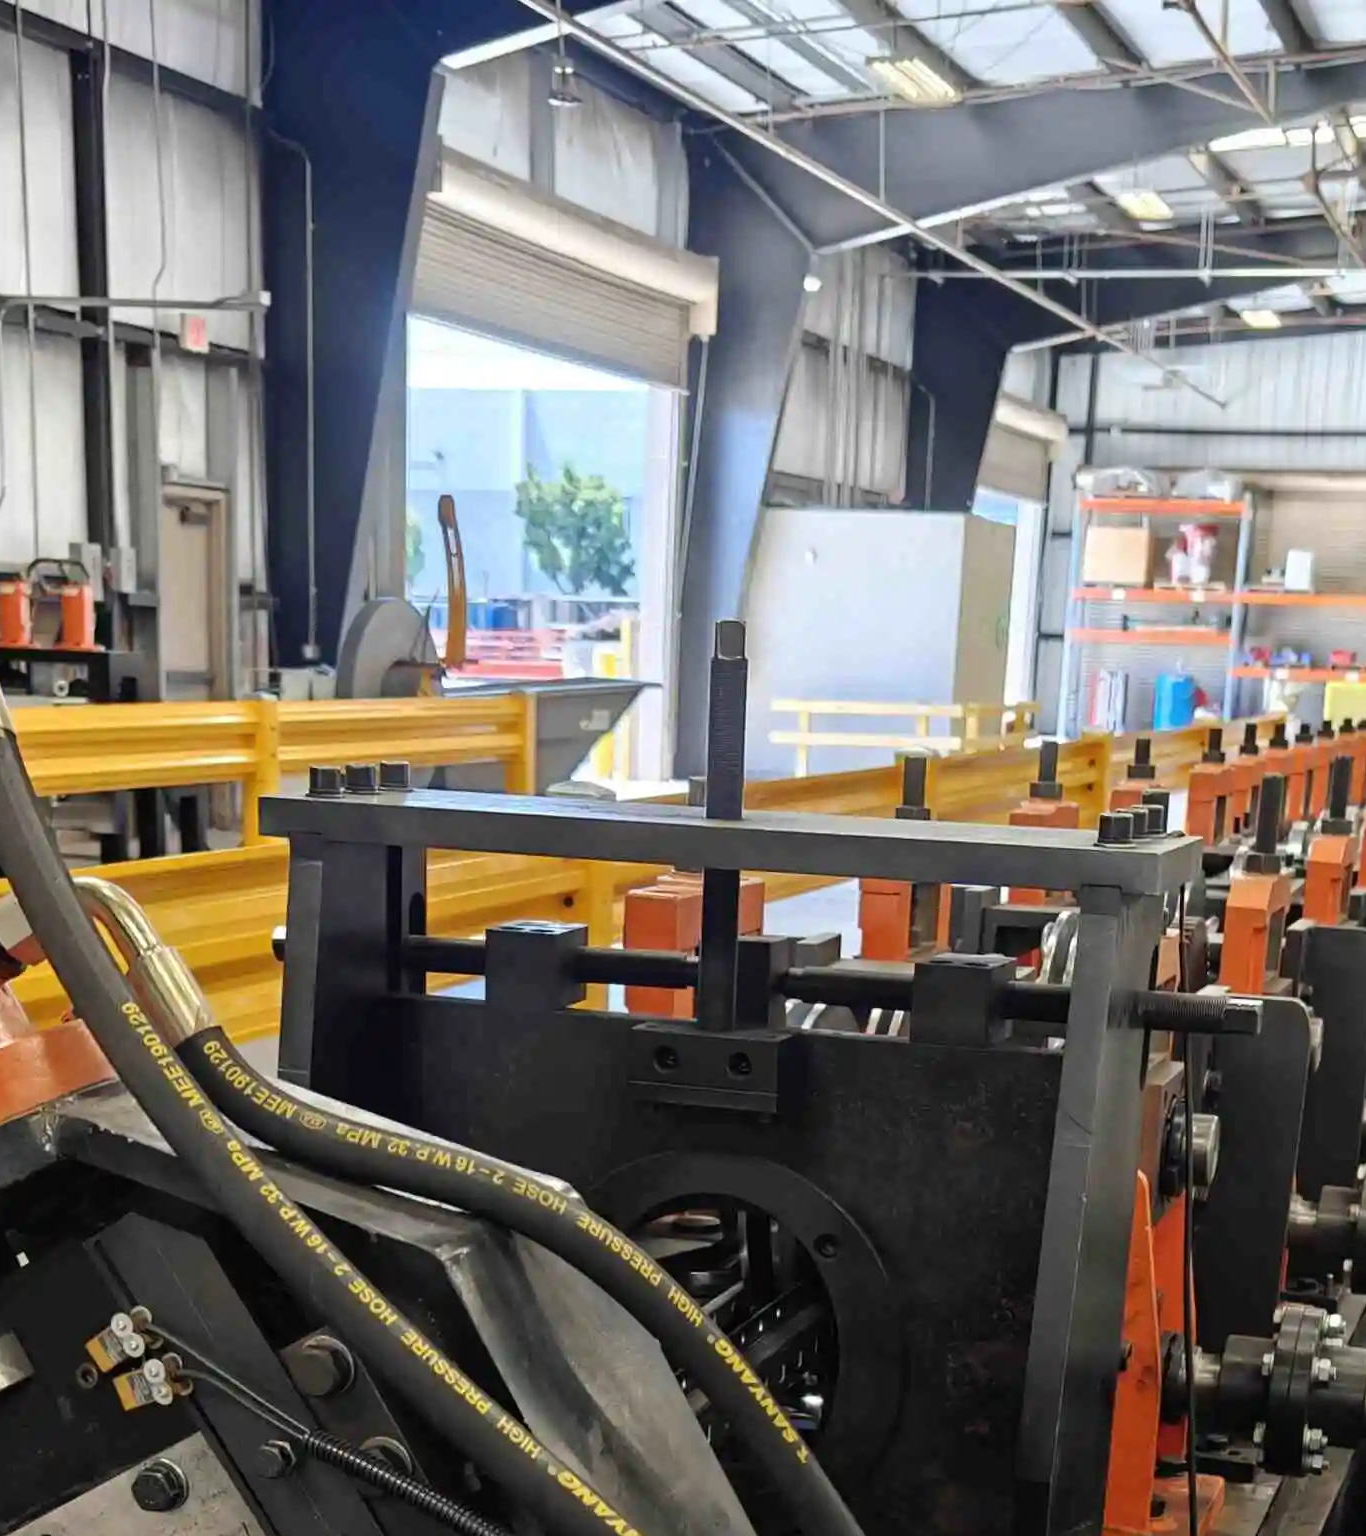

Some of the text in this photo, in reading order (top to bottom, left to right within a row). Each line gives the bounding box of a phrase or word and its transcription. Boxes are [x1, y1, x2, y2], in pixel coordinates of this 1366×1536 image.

[121, 1002, 203, 1108] MEE190129
[204, 1039, 296, 1116] MEE190129
[336, 1126, 383, 1145] MPa
[391, 1140, 409, 1155] 32
[228, 1138, 262, 1181] MPa
[259, 1183, 280, 1205] 32
[515, 1180, 566, 1211] HOSE
[578, 1215, 660, 1284] PRESSURE
[348, 1280, 399, 1325] HOSE
[669, 1290, 703, 1328] HIGH
[401, 1332, 491, 1415] PRESSURE
[500, 1421, 540, 1455] HIGH
